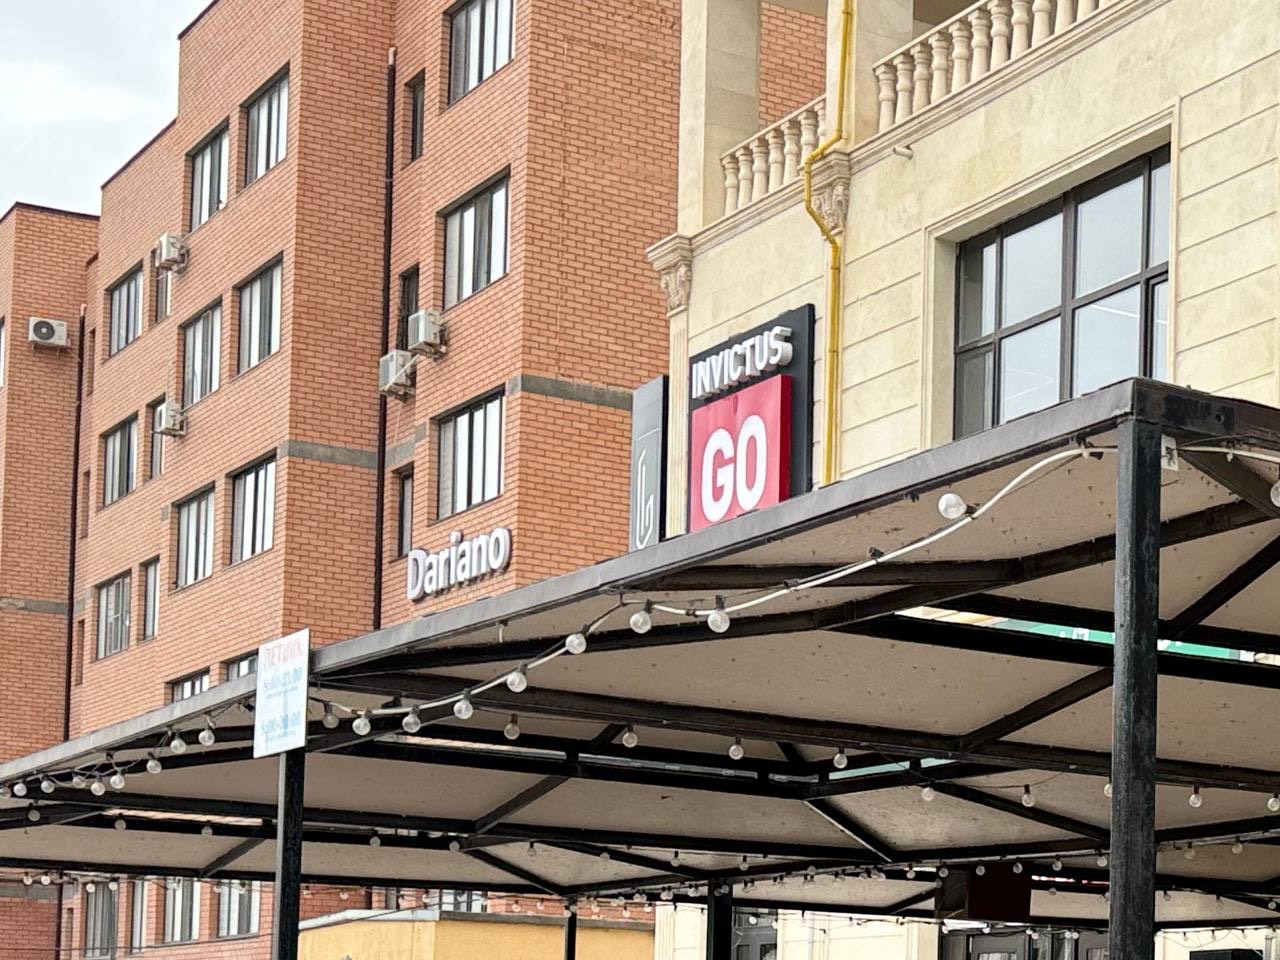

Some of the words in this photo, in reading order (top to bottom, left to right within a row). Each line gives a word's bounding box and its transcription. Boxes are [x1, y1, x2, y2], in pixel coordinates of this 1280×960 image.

[692, 326, 793, 399] INVICTUS
[701, 415, 767, 523] GO
[406, 528, 510, 600] Dariano
